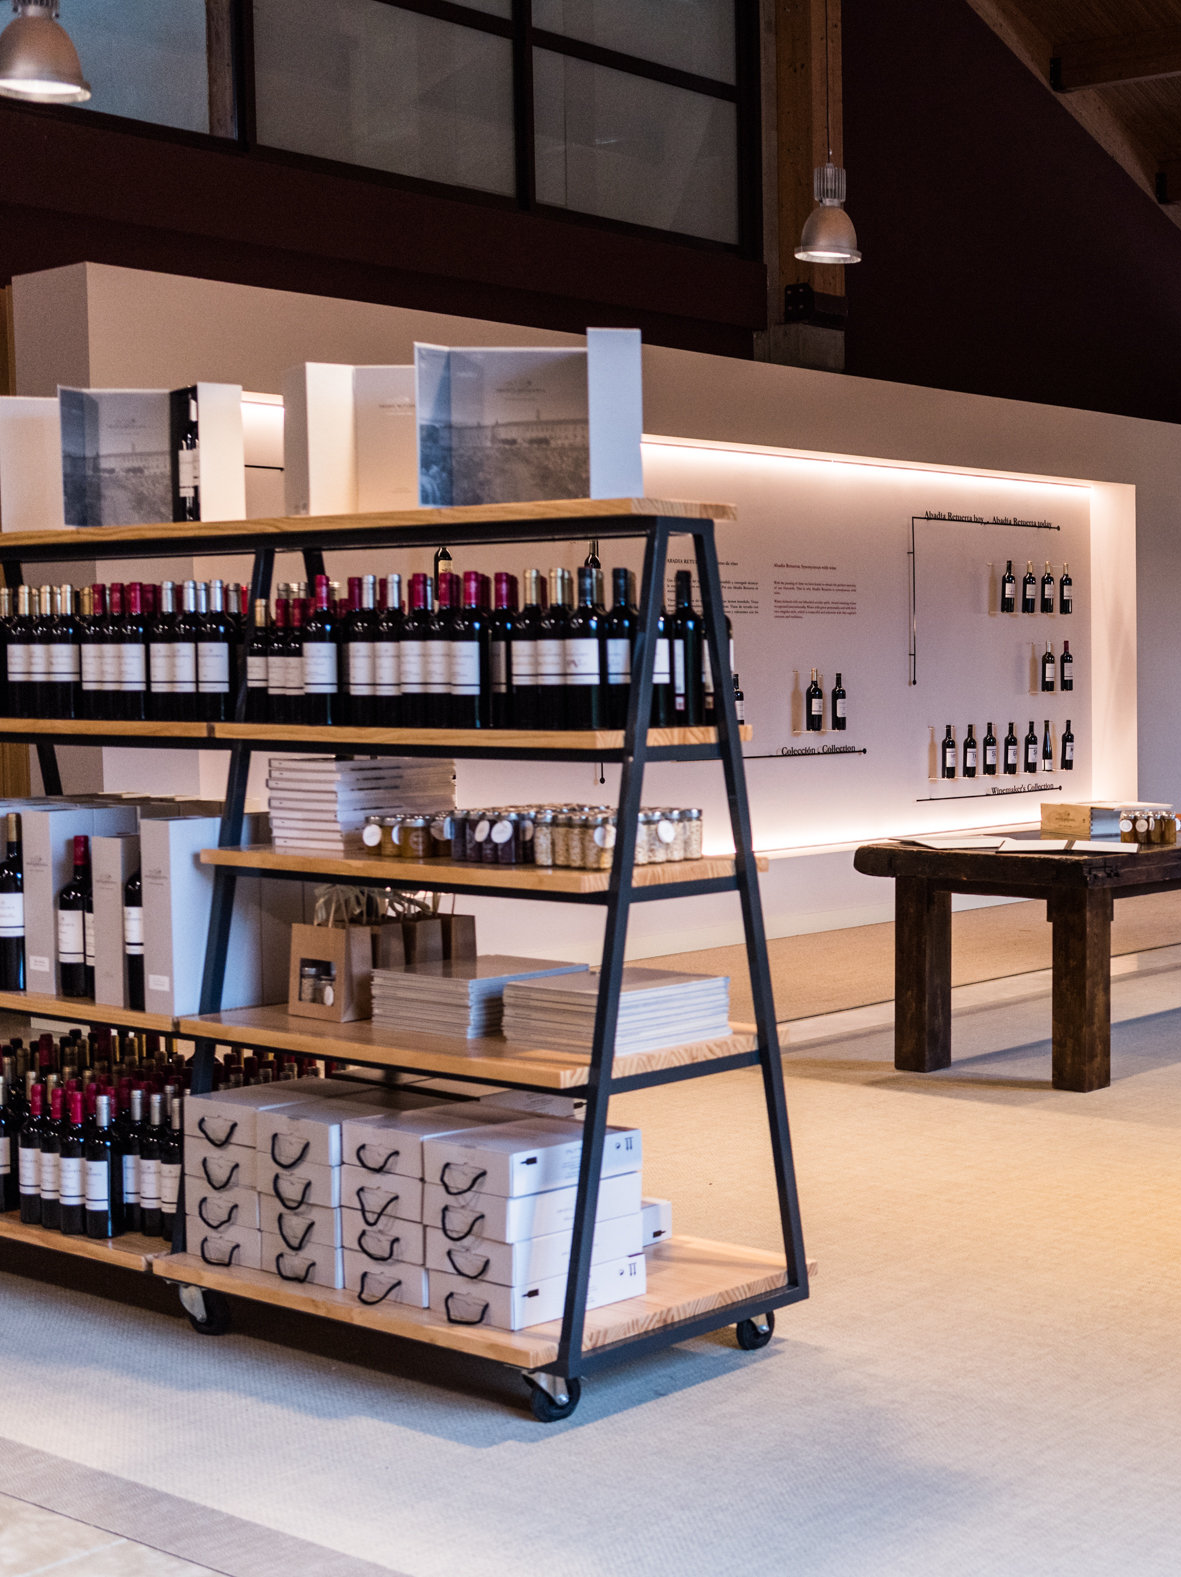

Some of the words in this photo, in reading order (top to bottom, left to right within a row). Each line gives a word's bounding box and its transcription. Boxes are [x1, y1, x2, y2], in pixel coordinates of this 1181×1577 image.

[1037, 519, 1052, 530] today
[781, 746, 816, 756] Colección
[822, 744, 856, 753] Collection
[991, 784, 1026, 795] Winemaker's
[1026, 782, 1054, 792] Collection
